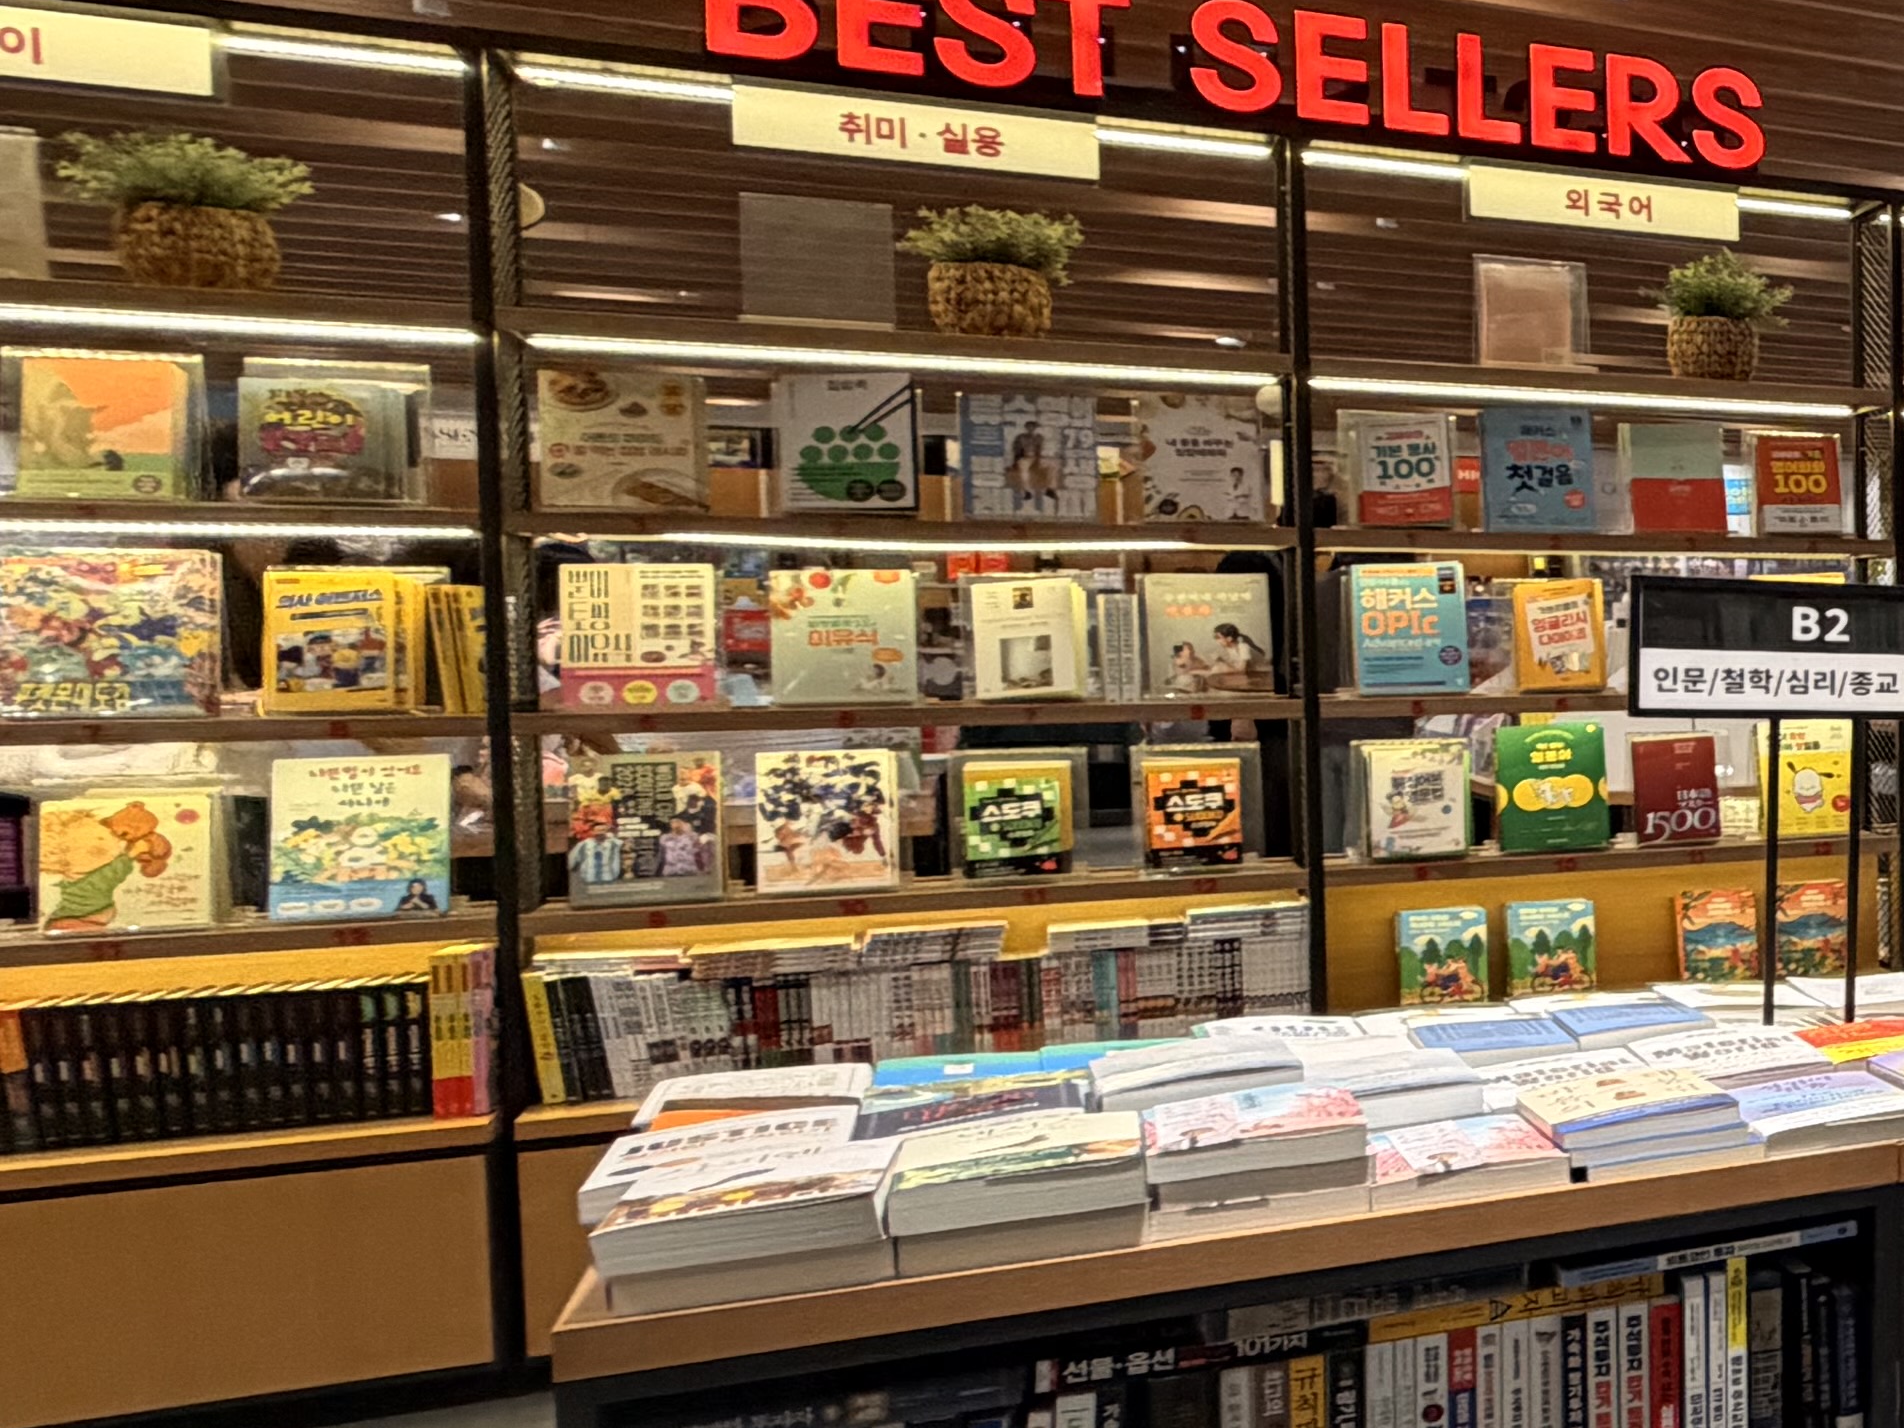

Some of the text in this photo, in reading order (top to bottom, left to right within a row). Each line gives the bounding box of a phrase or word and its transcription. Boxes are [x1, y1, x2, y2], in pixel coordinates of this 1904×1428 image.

[838, 111, 1006, 159] 취미 실용
[1563, 188, 1655, 225] 외국어
[1376, 456, 1437, 481] 100
[1773, 474, 1827, 495] 100
[1360, 586, 1439, 609] 해커스
[1790, 606, 1852, 644] B2
[1651, 664, 1899, 699] 인문/철학/심리/종교
[978, 797, 1042, 825] 스도쿠
[1160, 789, 1222, 817] 스도쿠
[1645, 806, 1717, 835] 1500
[1651, 1029, 1798, 1061] Material
[1687, 1044, 1778, 1069] World
